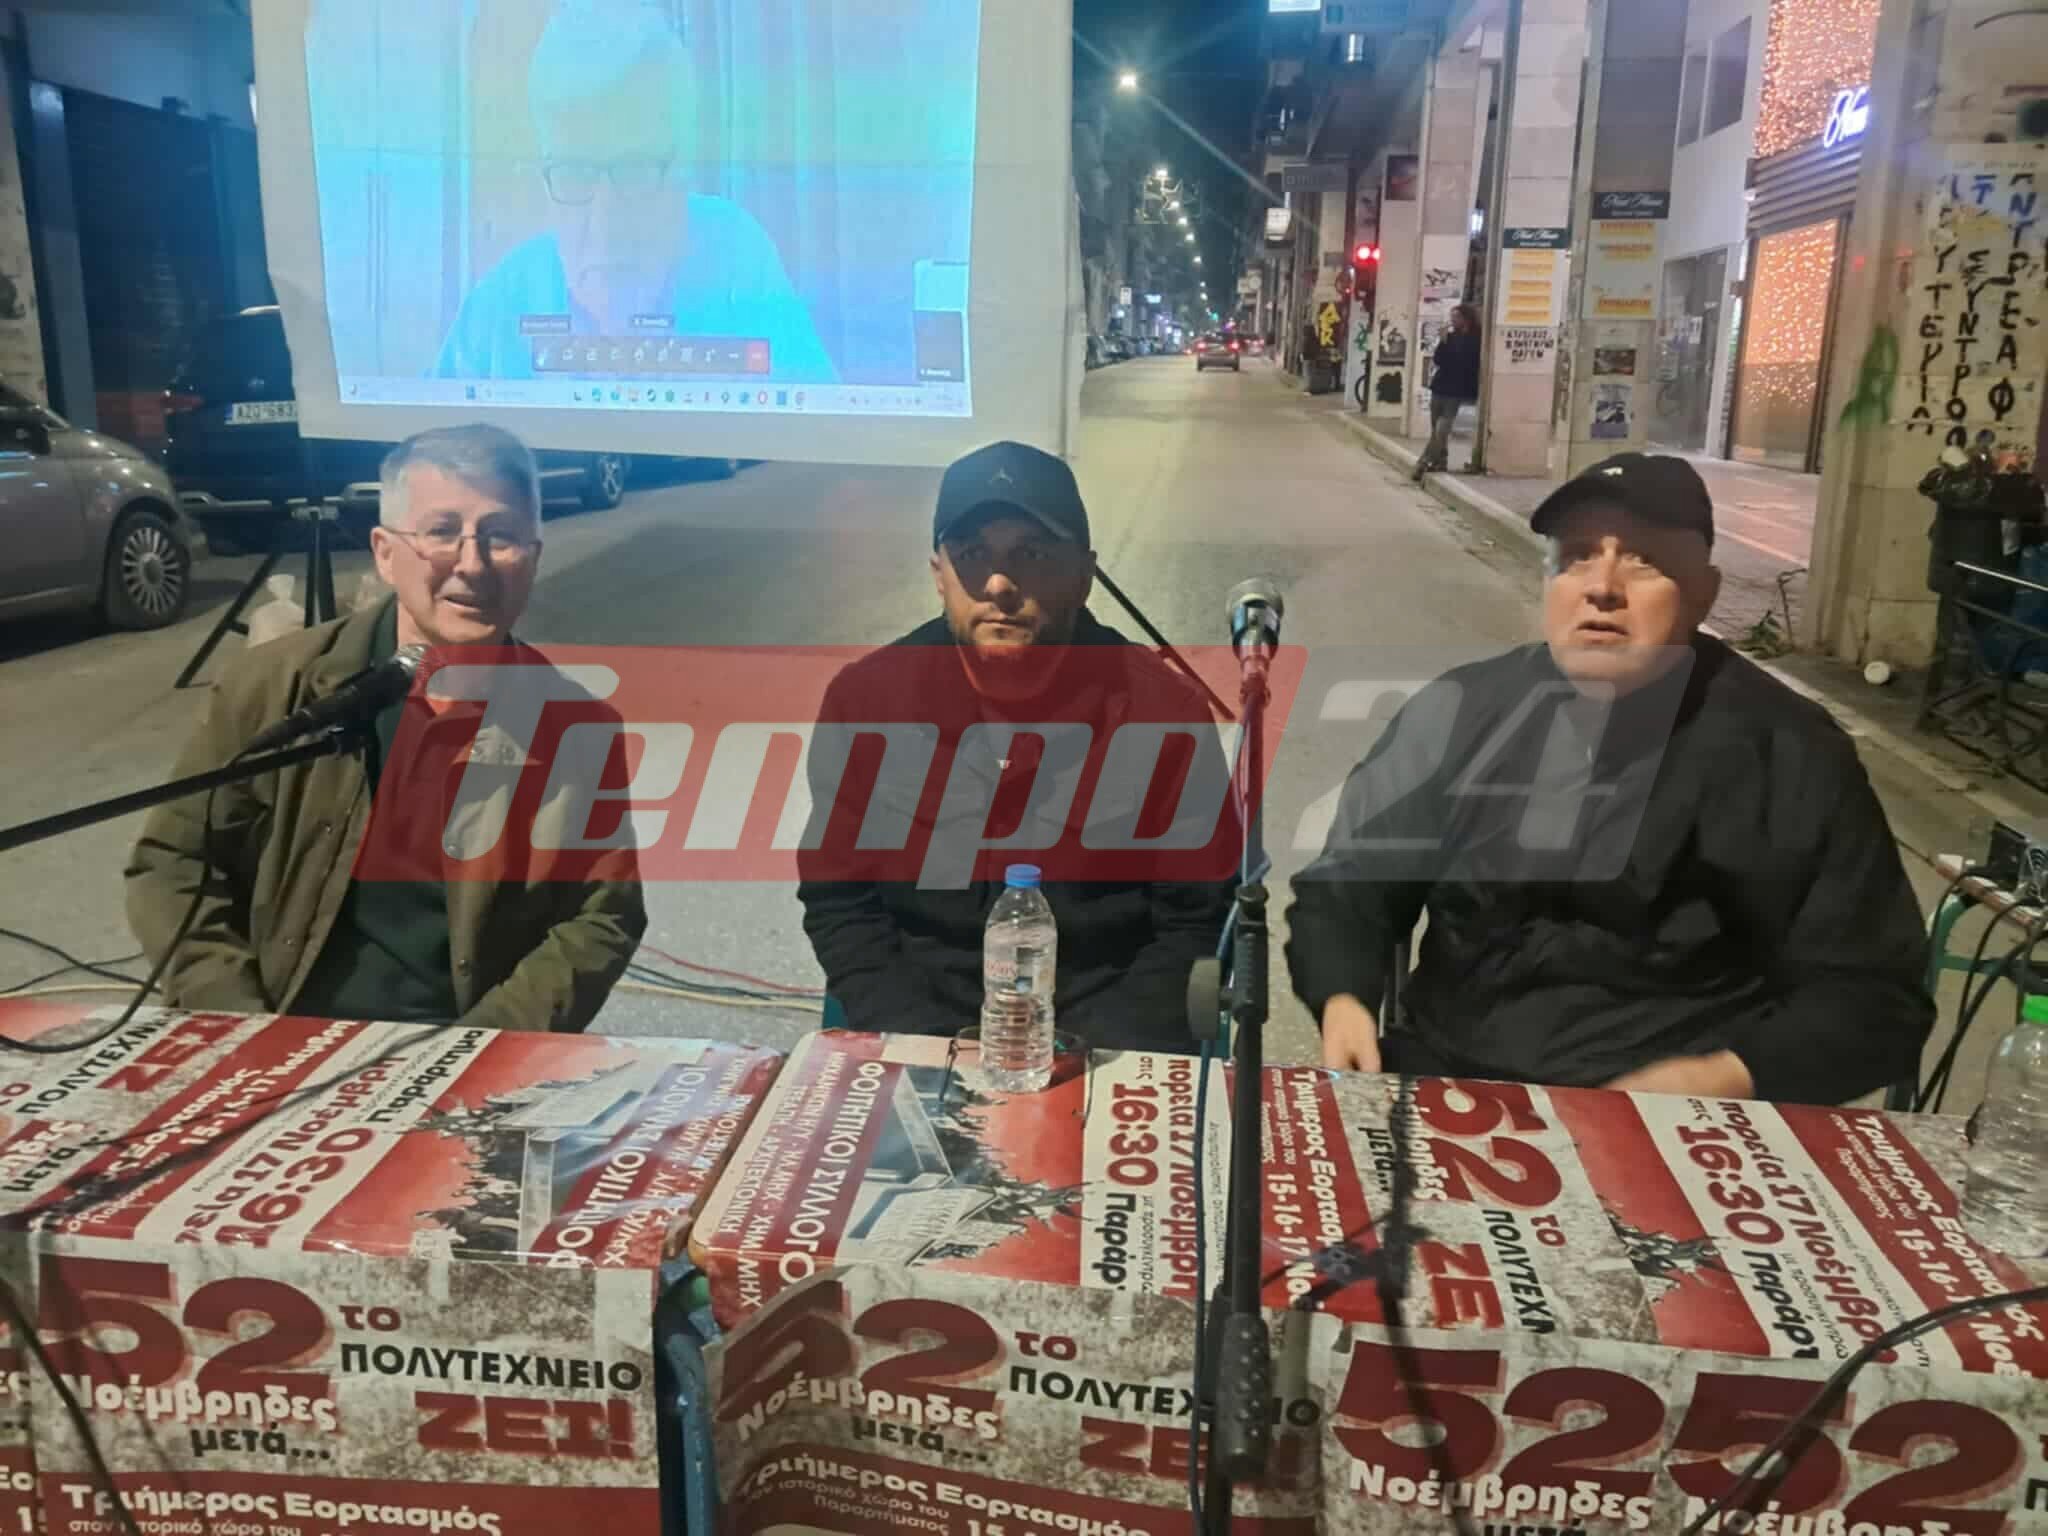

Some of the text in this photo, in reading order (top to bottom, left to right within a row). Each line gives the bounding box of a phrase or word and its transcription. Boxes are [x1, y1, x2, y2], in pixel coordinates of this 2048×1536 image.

[366, 1029, 486, 1124] Παράρτημα
[1289, 1070, 1328, 1158] Τριήμερος
[233, 1152, 284, 1181] 17
[778, 1062, 886, 1289] ΦΟΙΤΗΤΙΚΟΙ ΣΥΛΛΟΓΟ
[1106, 1083, 1159, 1187] 16:30
[1415, 1077, 1563, 1207] 52
[1716, 1100, 1788, 1179] πορεία
[1768, 1182, 1818, 1217] 17
[1856, 1114, 1943, 1214] Τριήμερος
[214, 1127, 375, 1249] 16:30
[1676, 1124, 1785, 1245] 16:30
[1091, 1193, 1136, 1291] Παράρ
[1530, 1214, 1567, 1247] το
[37, 1253, 336, 1400] 52
[338, 1304, 401, 1332] το
[1014, 1331, 1078, 1362] το
[60, 1373, 338, 1432] Νοέμβρηδες
[340, 1342, 643, 1392] ΠΟΛΥΤΕΧΝΕΙΟ
[735, 1370, 999, 1443] Νοέμβρηδες
[190, 1420, 332, 1460] μετά...
[414, 1390, 637, 1461] ΖΕΙ!
[1332, 1340, 1665, 1492] 52
[1666, 1371, 2023, 1516] 52
[283, 1491, 502, 1535] Εορτασμός
[1349, 1456, 1655, 1531] Νοέμβρηδες
